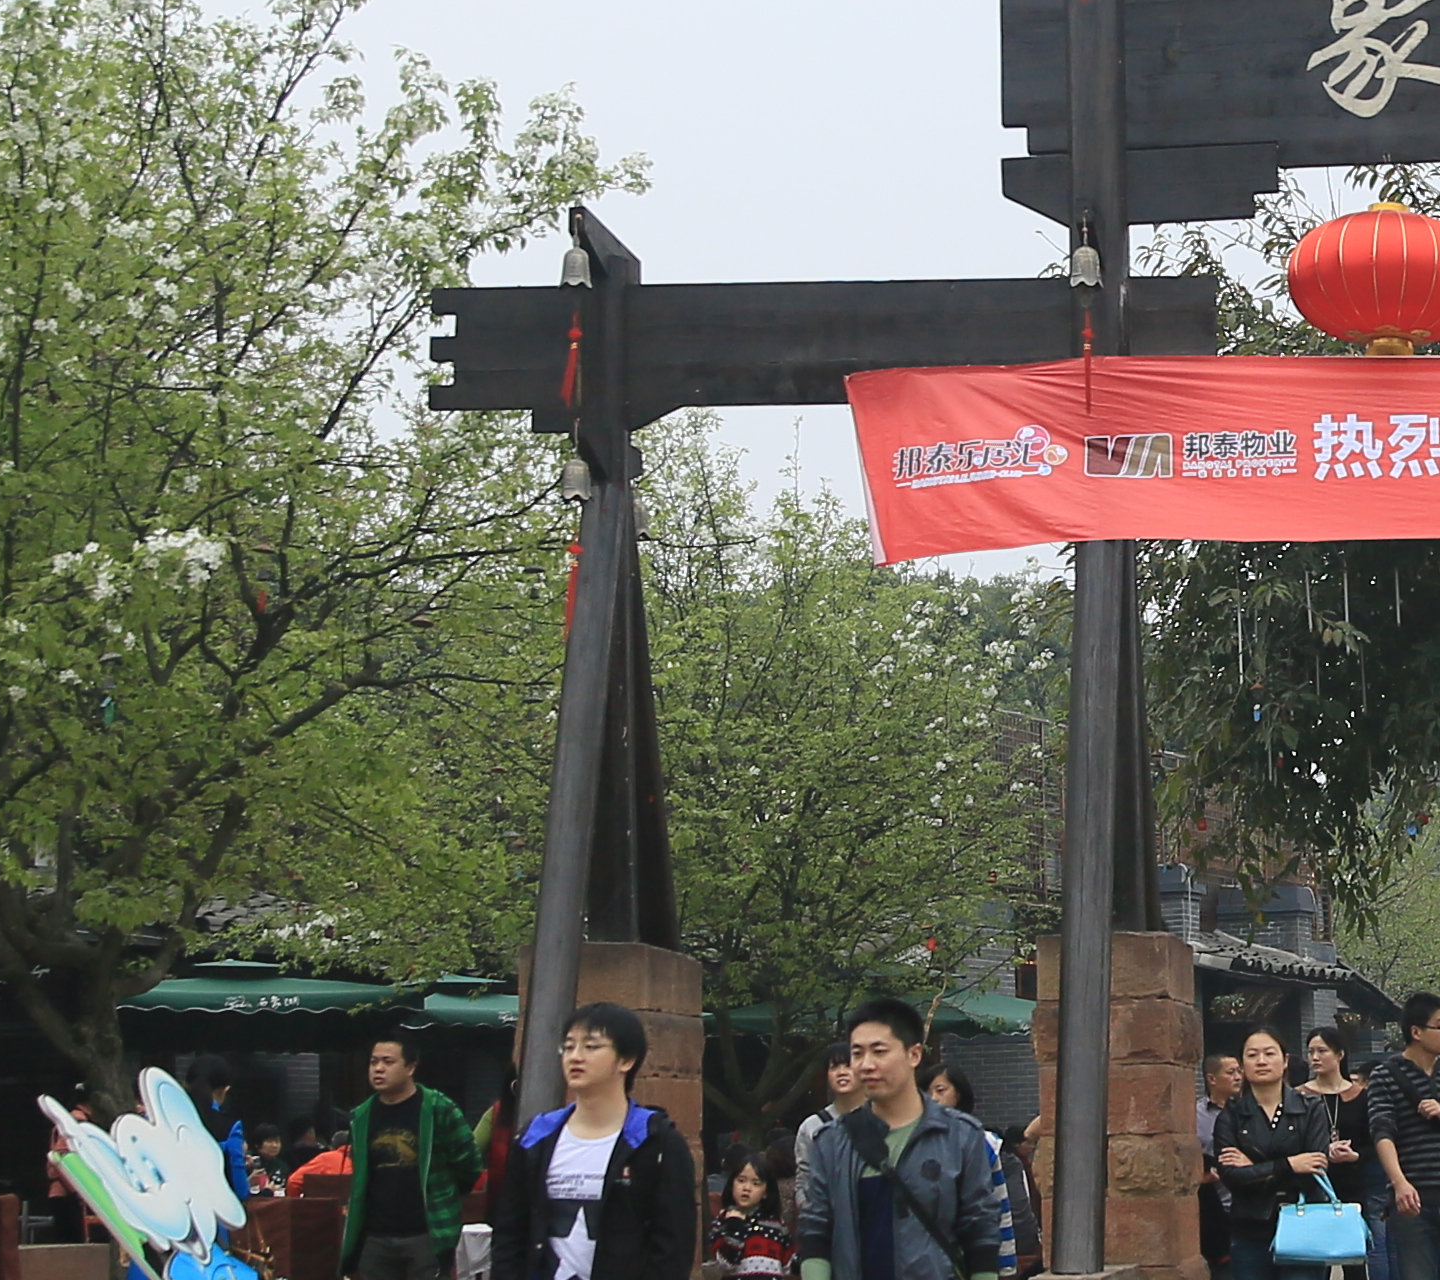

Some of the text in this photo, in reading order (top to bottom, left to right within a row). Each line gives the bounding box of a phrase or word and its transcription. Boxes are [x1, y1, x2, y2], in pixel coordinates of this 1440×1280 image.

[892, 439, 1042, 480] 邦泰乐居汇
[1183, 430, 1297, 460] 邦泰物业
